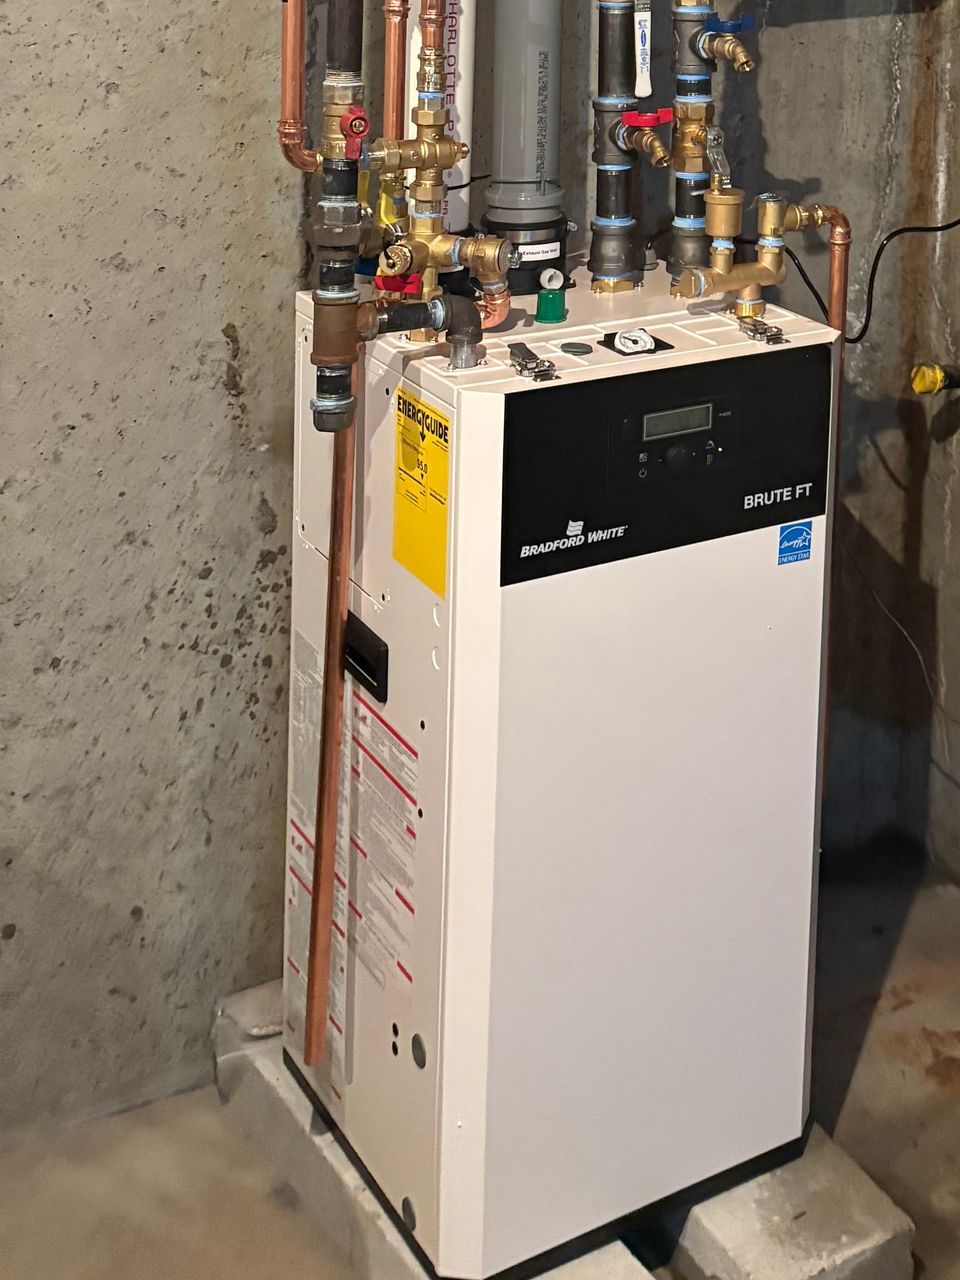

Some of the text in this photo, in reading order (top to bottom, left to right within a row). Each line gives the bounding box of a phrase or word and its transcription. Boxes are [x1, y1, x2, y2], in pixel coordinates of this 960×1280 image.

[743, 483, 812, 510] BRUTE FT
[520, 526, 626, 558] BRADFORD WHITE
[779, 555, 798, 564] ENERGY
